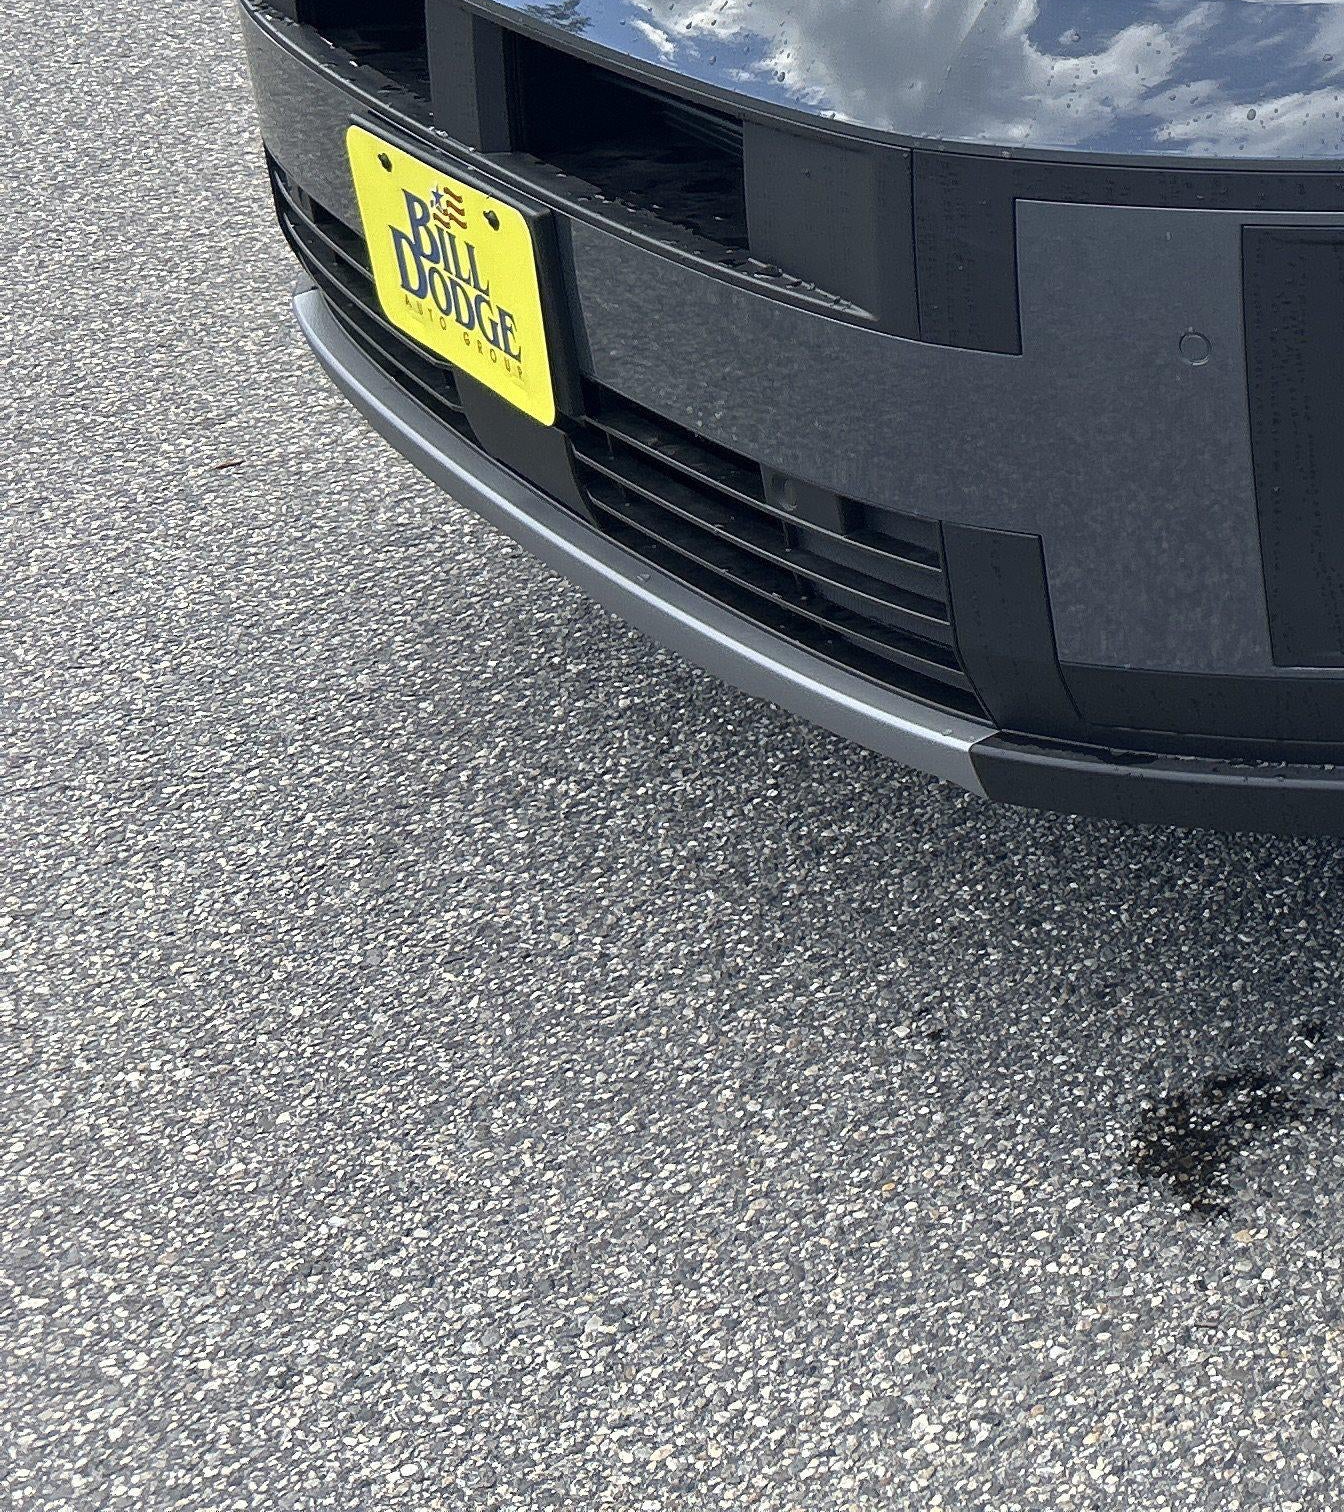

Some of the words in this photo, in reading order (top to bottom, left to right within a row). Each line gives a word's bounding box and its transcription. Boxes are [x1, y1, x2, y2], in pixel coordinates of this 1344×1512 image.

[388, 224, 522, 364] DODGE
[401, 188, 490, 297] BILL
[404, 294, 447, 331] AUTO
[463, 331, 524, 381] GROUP
